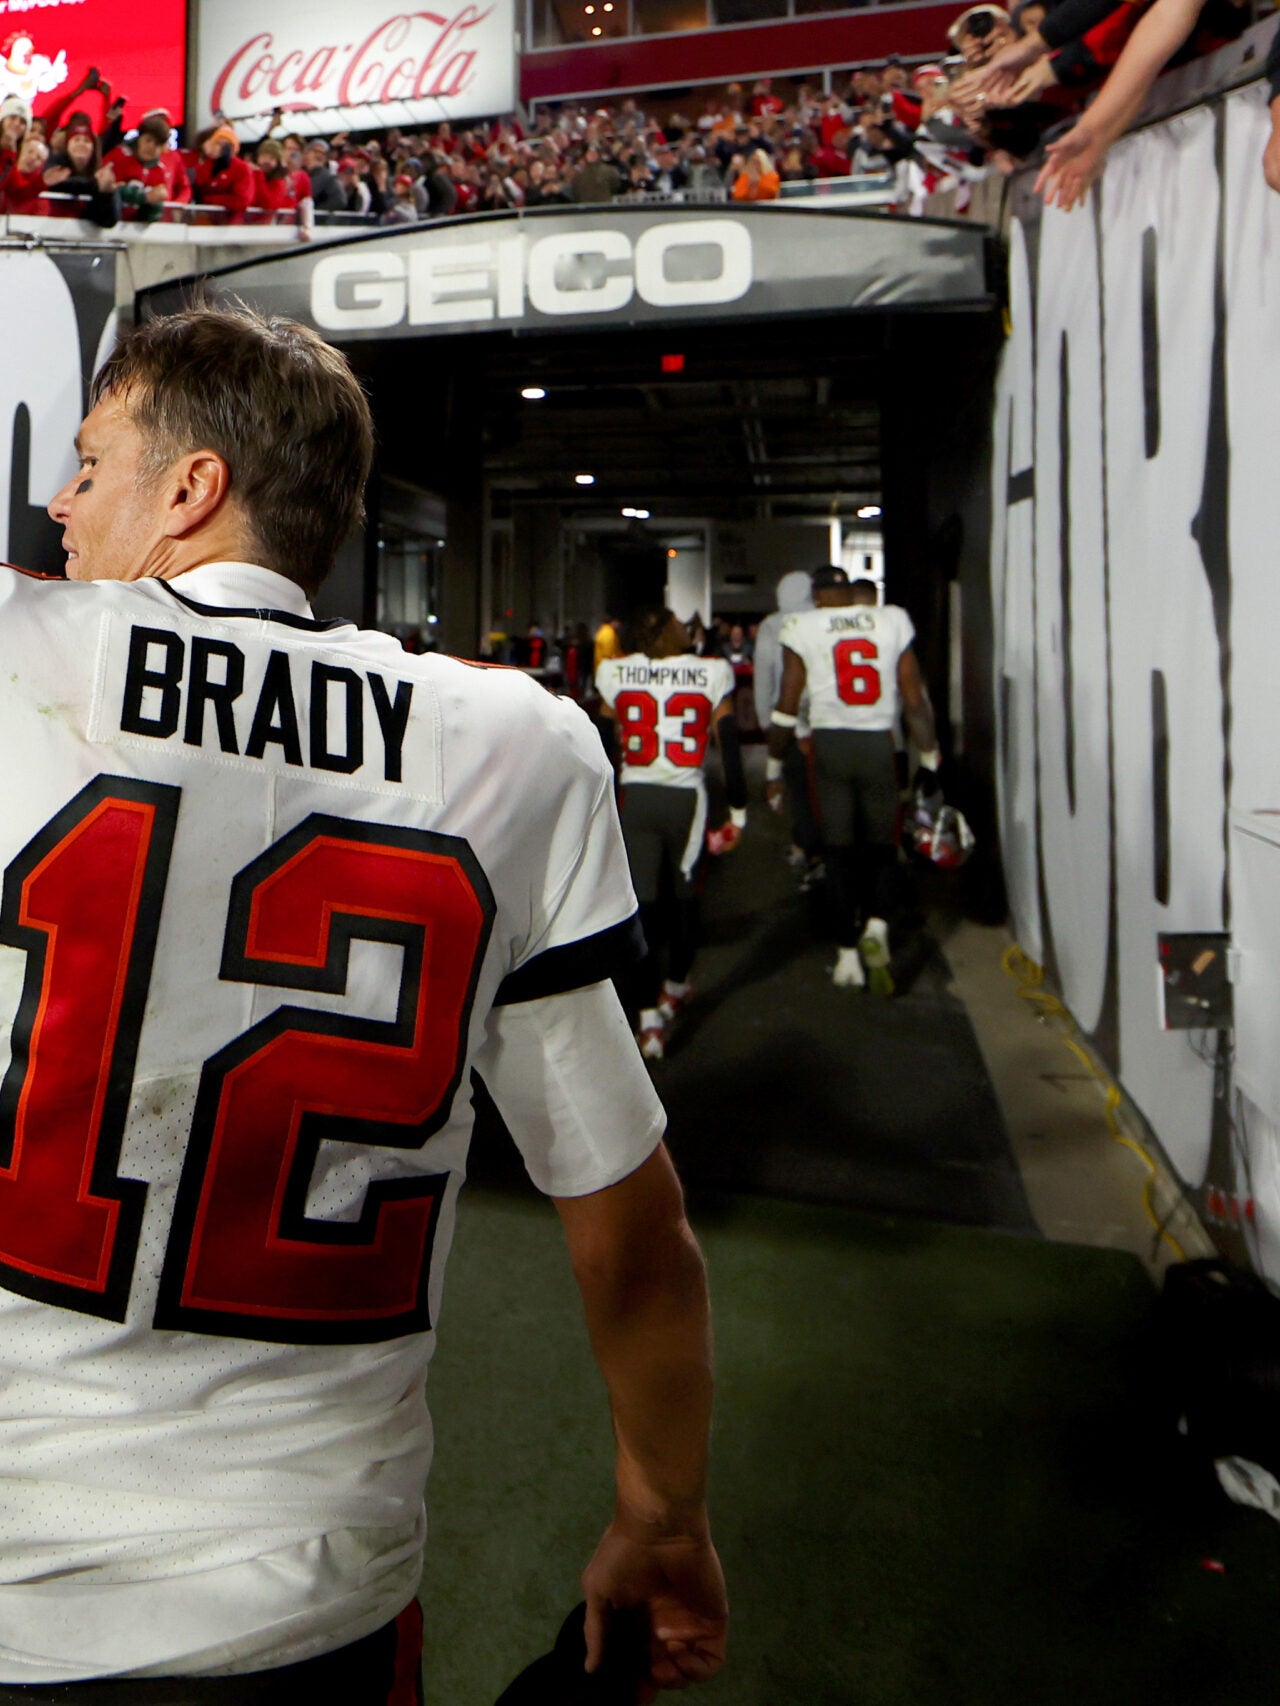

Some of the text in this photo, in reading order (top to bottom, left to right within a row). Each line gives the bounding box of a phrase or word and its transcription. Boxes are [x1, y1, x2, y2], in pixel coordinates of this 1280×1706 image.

[310, 218, 754, 331] GEICO
[827, 613, 877, 634] JONES
[121, 625, 414, 783] BRADY
[616, 664, 710, 688] THOMPKINS
[832, 637, 882, 706] 6
[614, 689, 713, 767] 83
